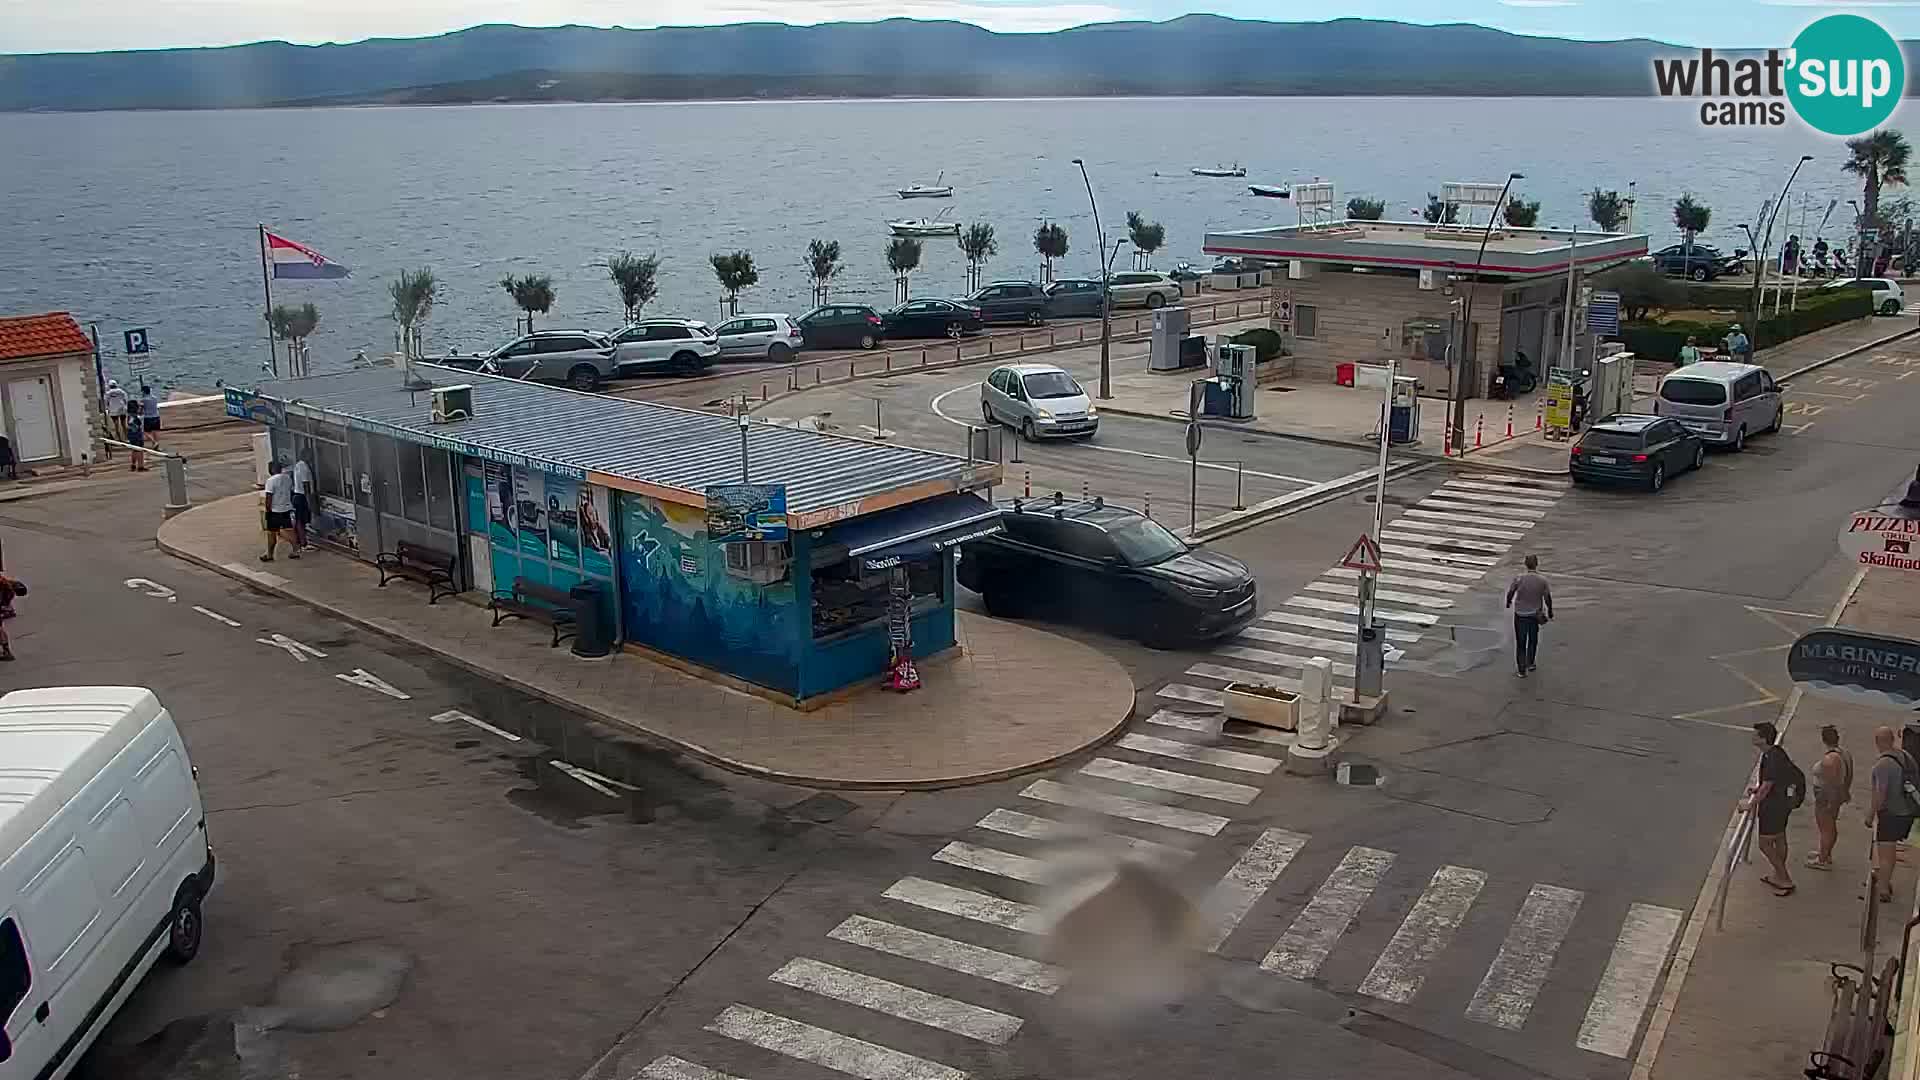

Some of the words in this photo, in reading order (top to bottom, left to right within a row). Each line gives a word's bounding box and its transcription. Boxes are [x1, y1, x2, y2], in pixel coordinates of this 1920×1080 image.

[130, 332, 143, 351] P
[494, 451, 526, 467] STATION
[527, 459, 554, 473] TICKET
[555, 465, 583, 479] OFFICE
[1848, 516, 1920, 535] PIZZE
[1882, 531, 1917, 542] GRILL
[1870, 666, 1897, 681] bar
